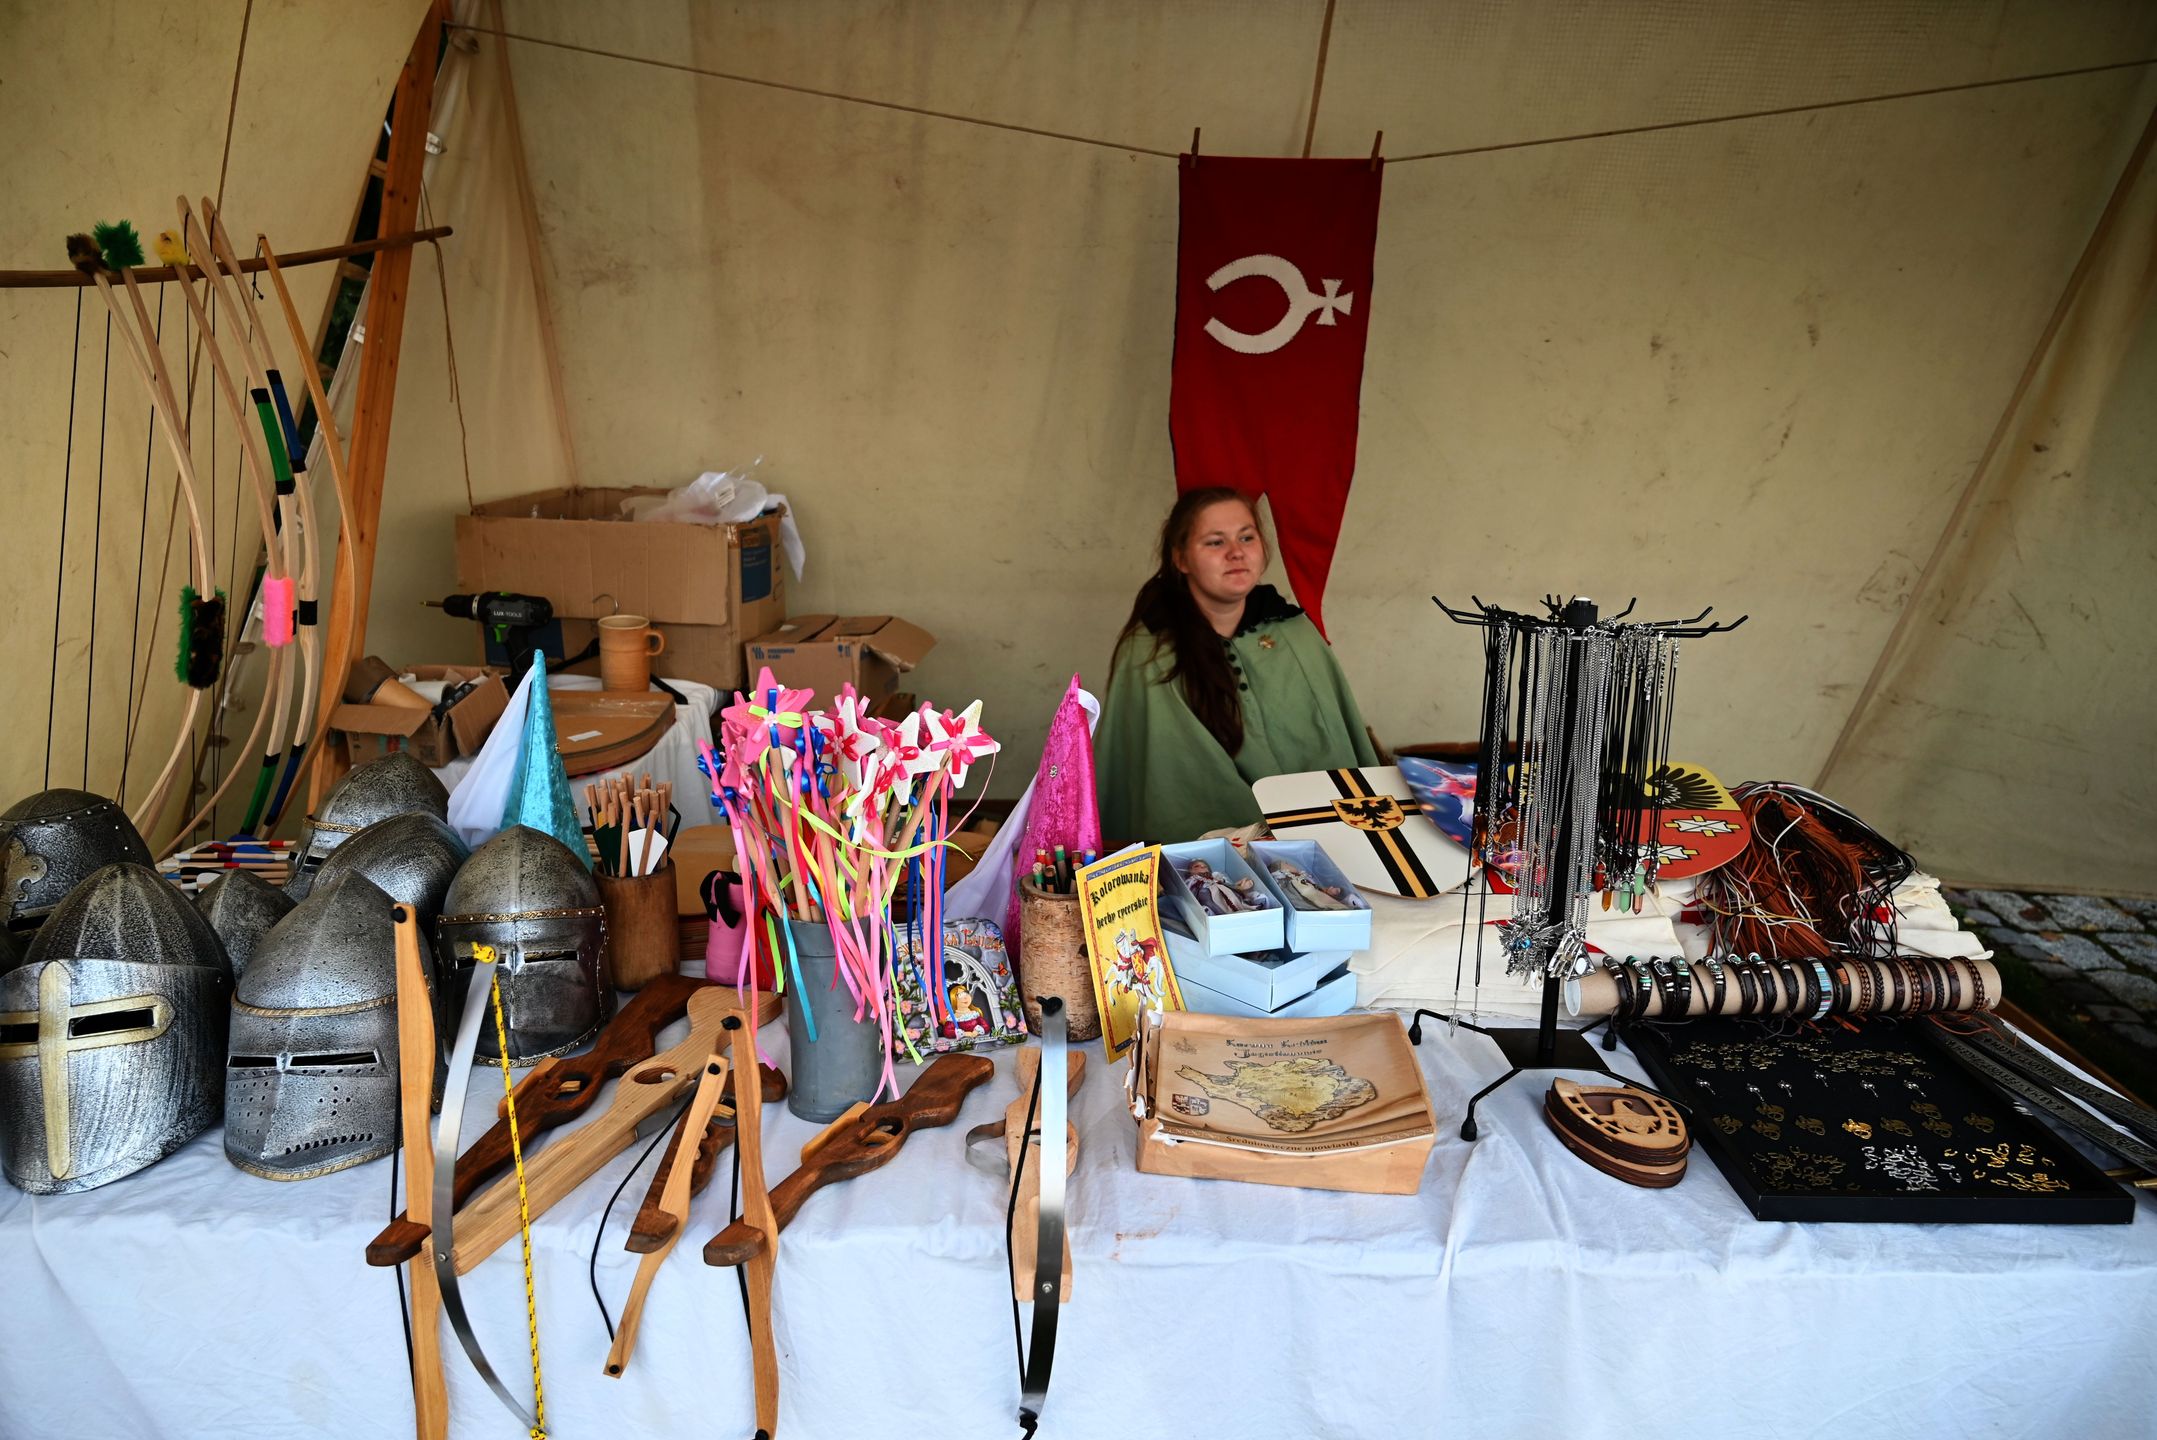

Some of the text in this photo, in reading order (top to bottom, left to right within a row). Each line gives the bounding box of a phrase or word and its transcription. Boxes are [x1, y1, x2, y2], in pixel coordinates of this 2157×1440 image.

[1090, 870, 1149, 907] Kolorowanka
[1096, 897, 1149, 930] herby rycerskie
